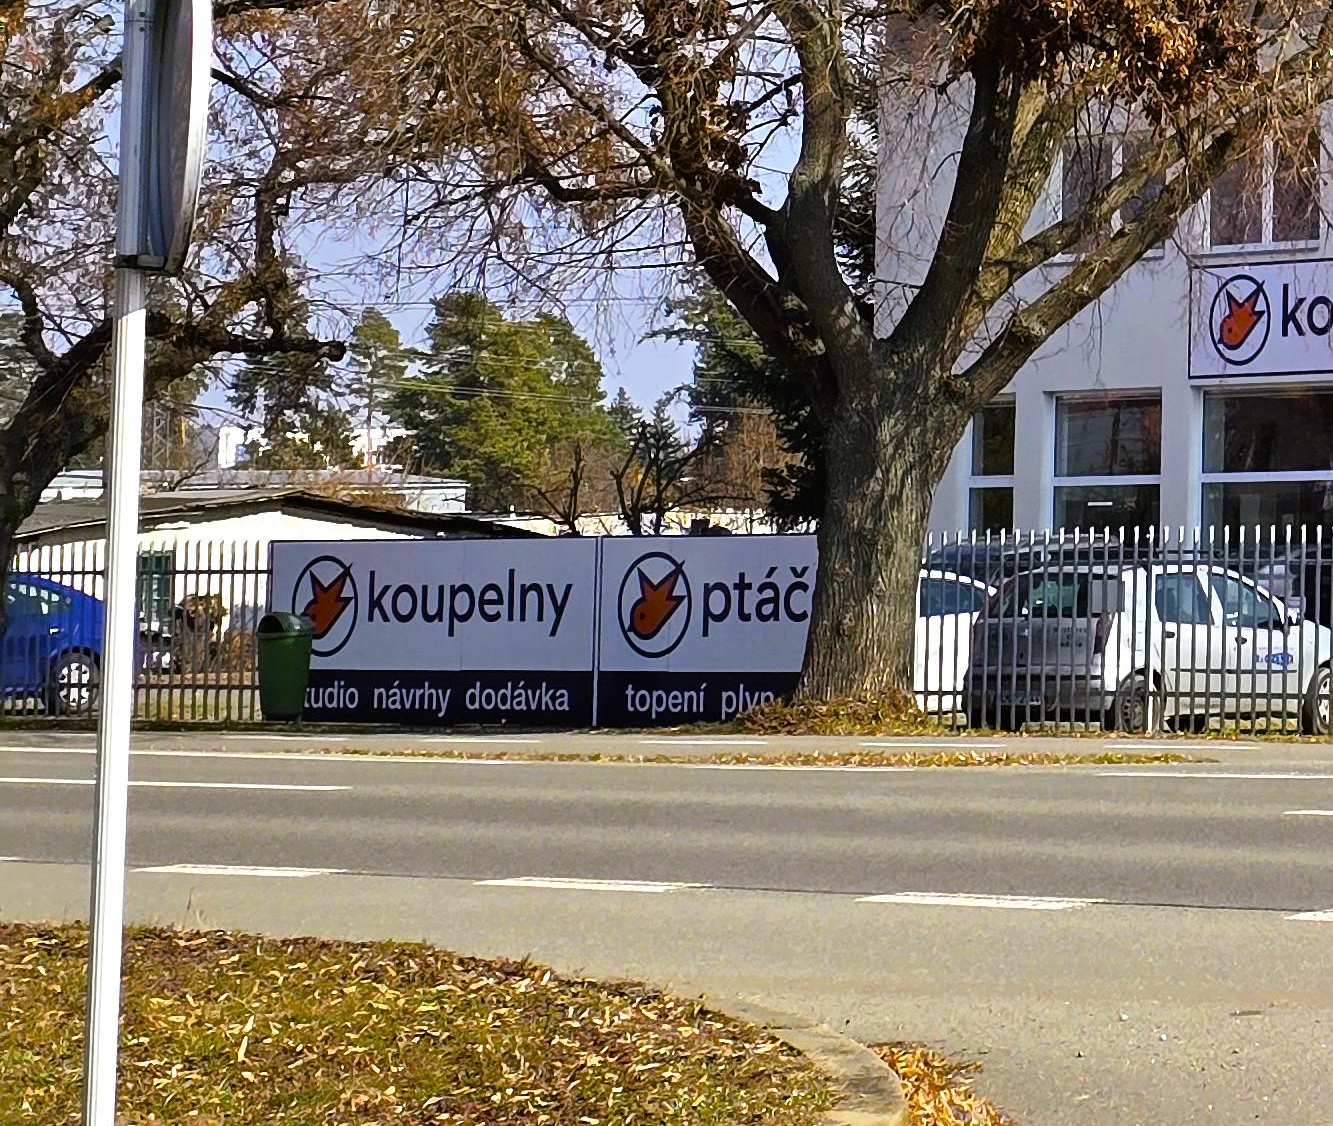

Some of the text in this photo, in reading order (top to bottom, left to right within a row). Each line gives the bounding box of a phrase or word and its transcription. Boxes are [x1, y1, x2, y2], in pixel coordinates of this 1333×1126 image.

[367, 568, 574, 638] koupelny
[702, 566, 810, 637] ptáč
[304, 680, 570, 718] tudio návrhy dodávka
[625, 682, 708, 719] topení
